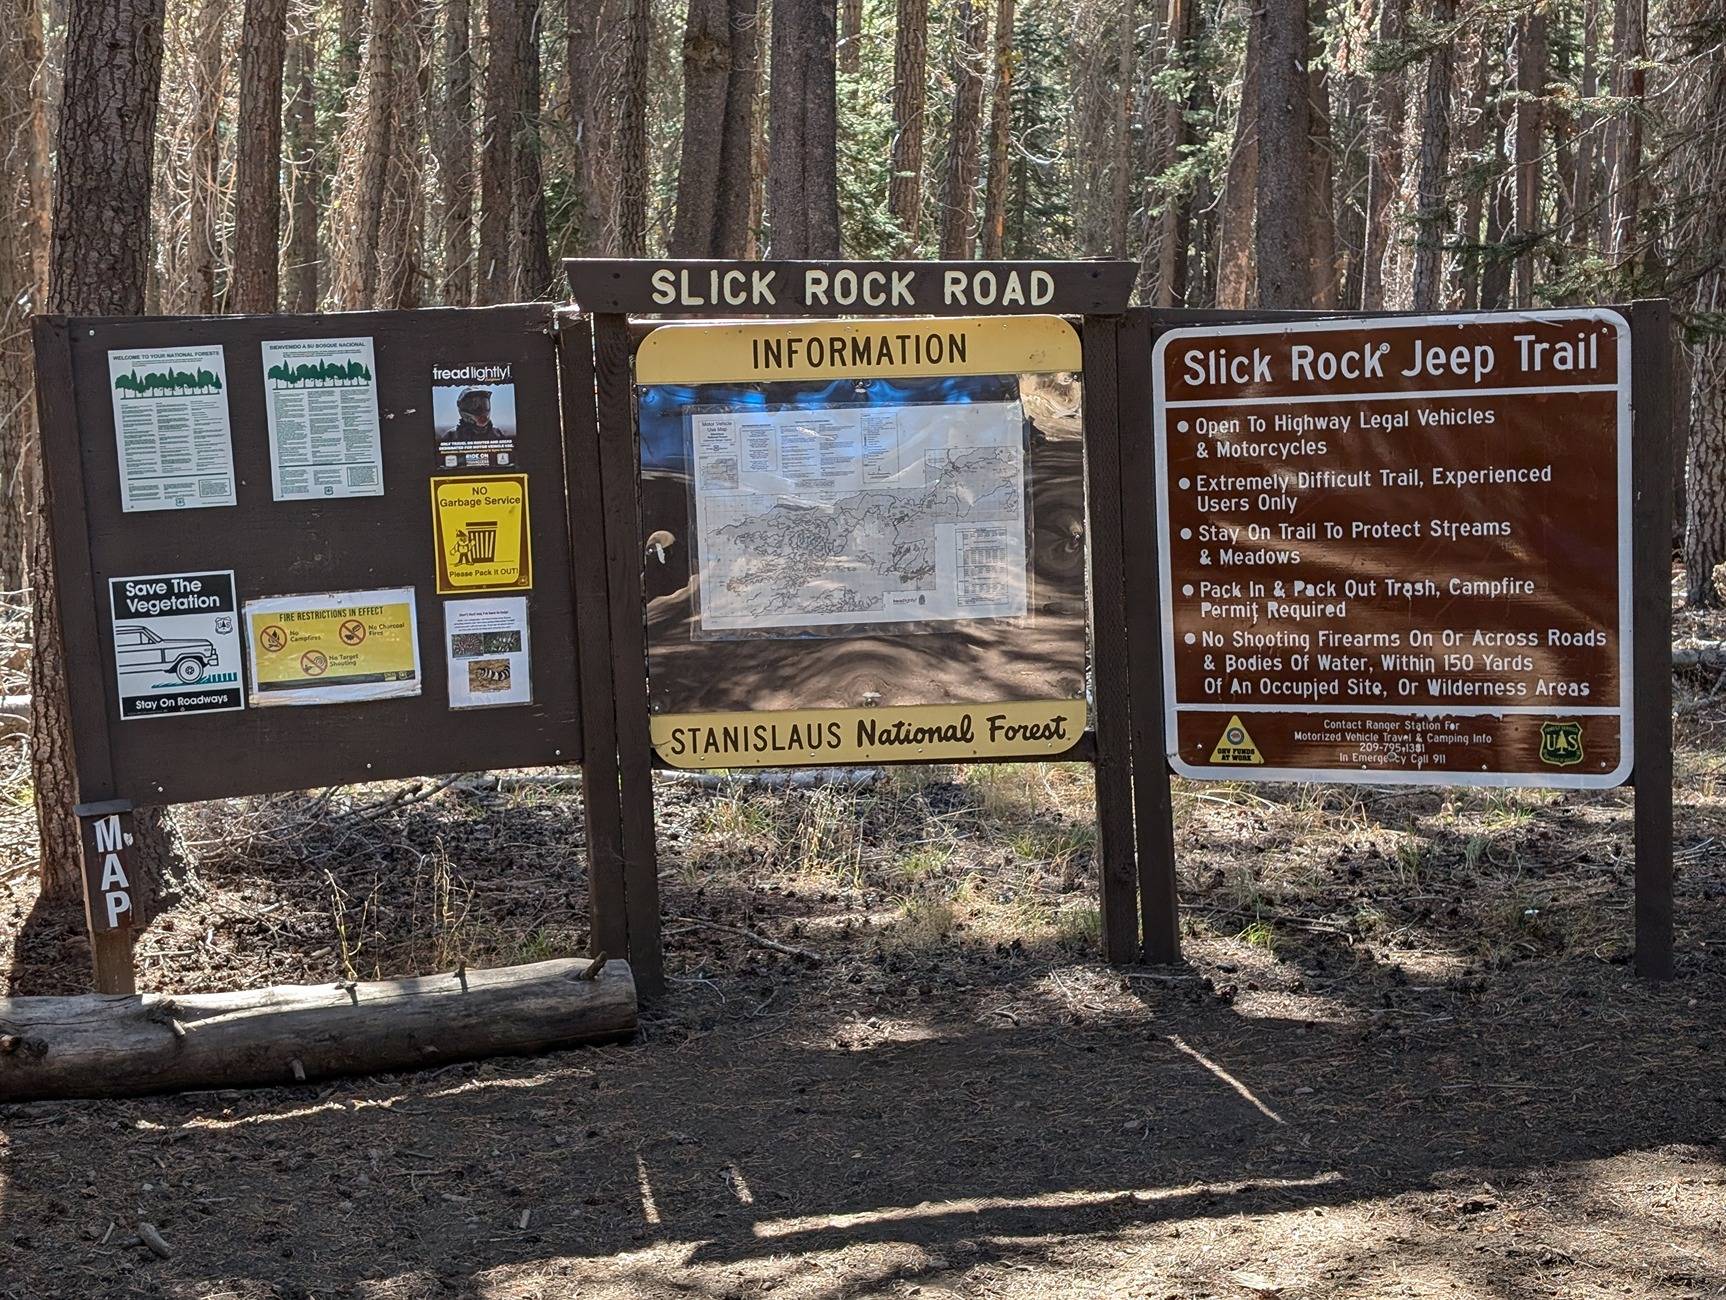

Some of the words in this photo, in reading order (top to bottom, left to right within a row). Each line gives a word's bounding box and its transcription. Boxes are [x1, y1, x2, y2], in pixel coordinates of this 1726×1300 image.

[651, 269, 776, 307] SLICK
[804, 270, 916, 306] ROCK
[943, 269, 1055, 307] ROAD
[752, 332, 967, 370] INFORMATION
[1184, 347, 1272, 386] Slick
[1291, 343, 1385, 382] Rock
[1401, 340, 1495, 384] Jeep
[1513, 332, 1598, 372] Trail
[1195, 417, 1239, 437] Open
[1247, 415, 1266, 433] To
[1274, 413, 1350, 437] Highway
[1360, 411, 1409, 432] Legal
[1417, 408, 1496, 426] Vehicles
[1197, 443, 1208, 458] &
[1217, 440, 1328, 461] Motorcycles
[1197, 475, 1289, 493] Extremely
[1298, 471, 1372, 489] Difficult
[1380, 468, 1424, 488] Trail,
[1432, 465, 1552, 486] Experienced
[472, 487, 488, 495] NO
[440, 498, 481, 508] Garbage
[484, 496, 520, 506] Service
[1198, 496, 1249, 513] Users
[1258, 493, 1298, 513] Only
[1198, 523, 1239, 545] Stay
[1248, 522, 1272, 541] On
[1278, 522, 1317, 540] Trail
[1323, 521, 1343, 539] To
[1351, 519, 1421, 539] Protect
[1430, 520, 1512, 541] Streams
[1199, 549, 1211, 566] &
[1219, 547, 1301, 566] Meadows
[449, 570, 473, 578] Please
[500, 567, 518, 575] OUT!
[126, 581, 167, 597] Save
[171, 578, 202, 594] The
[1200, 580, 1241, 599] Pack
[1249, 580, 1265, 598] In
[1272, 580, 1286, 598] &
[1294, 580, 1336, 598] Pack
[1345, 579, 1377, 597] Out
[1384, 578, 1440, 598] Trash,
[1448, 576, 1535, 598] Campfire
[126, 594, 220, 614] Vegetation
[279, 611, 294, 622] FIRE
[297, 608, 347, 621] RESTRICTIONS
[349, 608, 357, 616] IN
[358, 606, 384, 616] EFFECT
[1200, 603, 1258, 624] Permit
[1268, 601, 1346, 622] Required
[1202, 630, 1223, 647] No
[1232, 629, 1310, 649] Shooting
[1318, 629, 1400, 647] Firearms
[1409, 629, 1433, 647] On
[1442, 629, 1464, 646] Or
[1472, 629, 1538, 647] Across
[1548, 629, 1607, 646] Roads
[1204, 656, 1216, 671] &
[1226, 655, 1282, 673] Bodies
[1291, 655, 1309, 671] Of
[1317, 655, 1374, 674] Water,
[1380, 655, 1435, 673] Within
[1443, 655, 1472, 671] 150
[1481, 655, 1533, 672] Yards
[1204, 679, 1222, 695] Of
[1231, 679, 1251, 694] An
[1259, 679, 1340, 700] Occupied
[1347, 679, 1387, 698] Site,
[1399, 679, 1418, 696] Or
[1428, 679, 1526, 696] Wilderness
[1535, 678, 1590, 697] Areas
[136, 700, 158, 710] Stay
[160, 698, 176, 707] On
[178, 694, 228, 706] Roadways
[671, 722, 841, 755] STANISLAUS
[856, 714, 974, 748] National
[986, 714, 1067, 743] Forest
[1324, 720, 1361, 729] Contact
[1366, 720, 1400, 731] Ranger
[1405, 721, 1440, 731] Station
[1294, 732, 1341, 741] Motorized
[1346, 732, 1378, 742] Vehicle
[1383, 733, 1412, 742] Travel
[1416, 733, 1422, 742] &
[1427, 734, 1468, 745] Camping
[1474, 734, 1492, 743] Info
[1546, 735, 1556, 750] U
[1568, 735, 1578, 750] S
[1340, 752, 1348, 762] In
[1353, 753, 1406, 765] Emergecy
[1411, 754, 1428, 764] Call
[1433, 754, 1446, 764] 911
[94, 815, 130, 928] MAP
